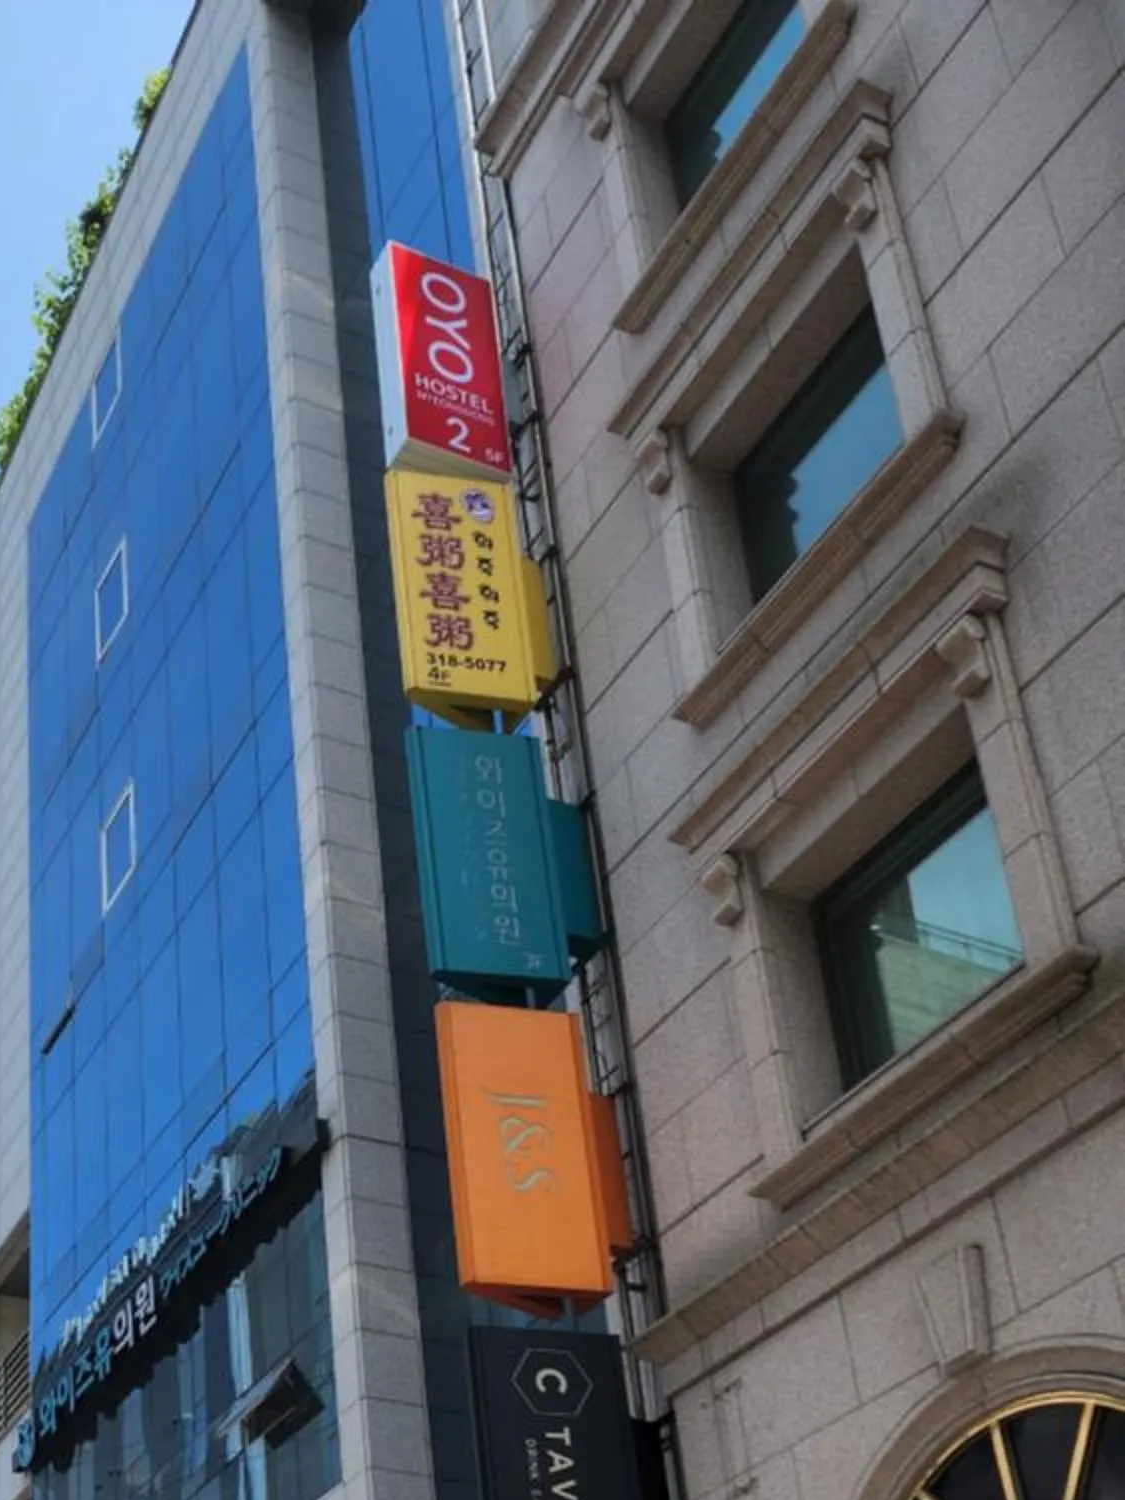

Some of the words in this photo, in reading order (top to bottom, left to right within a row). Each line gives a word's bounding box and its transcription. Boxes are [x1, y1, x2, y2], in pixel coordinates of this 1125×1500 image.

[421, 270, 474, 384] OYO
[415, 372, 495, 415] HOSTEL
[446, 416, 471, 453] 2
[426, 651, 507, 674] 318-5077
[38, 1275, 158, 1438] 와이즈유의원
[535, 1368, 569, 1395] C
